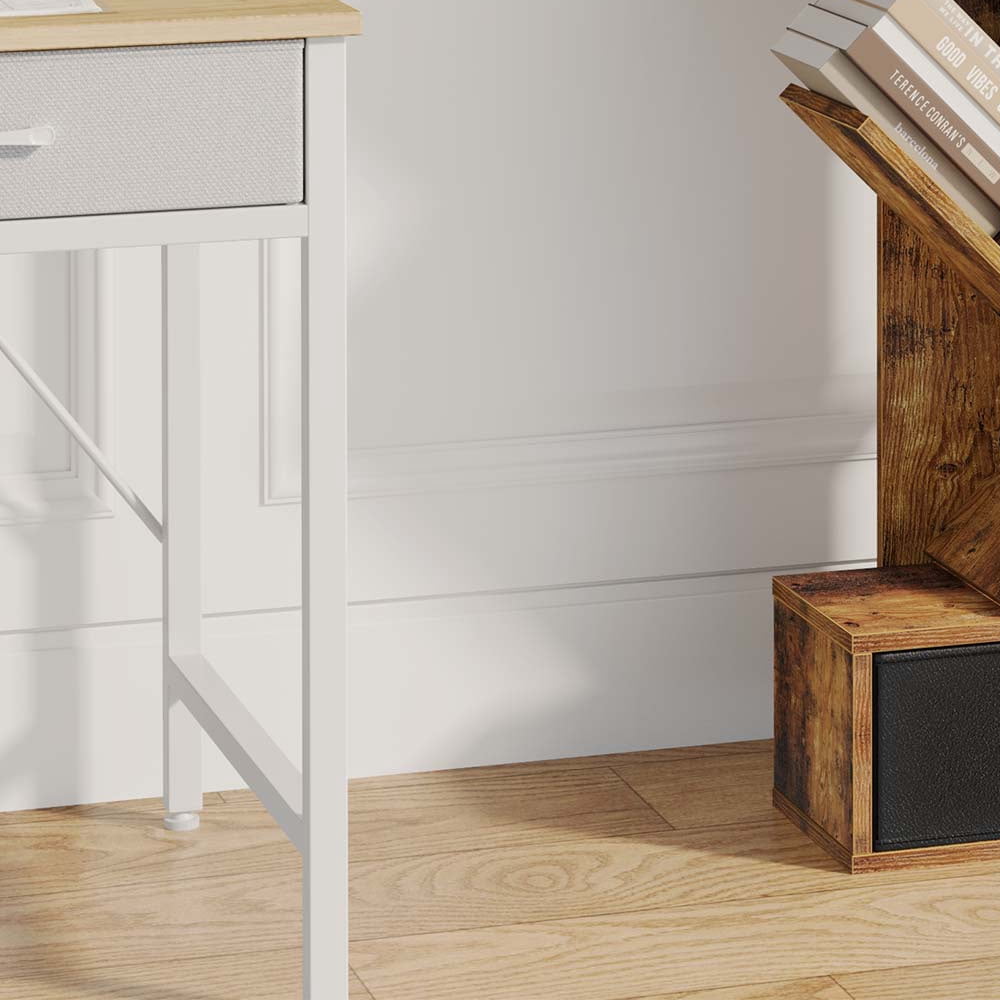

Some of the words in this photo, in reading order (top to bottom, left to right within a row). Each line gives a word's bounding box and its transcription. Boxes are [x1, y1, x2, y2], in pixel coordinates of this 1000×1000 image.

[962, 25, 984, 47] IN
[934, 35, 967, 68] GOOD
[964, 65, 998, 99] VIBES
[888, 70, 929, 110] TERENCE
[925, 106, 965, 147] CONRAN'S
[894, 123, 941, 170] barcelona
